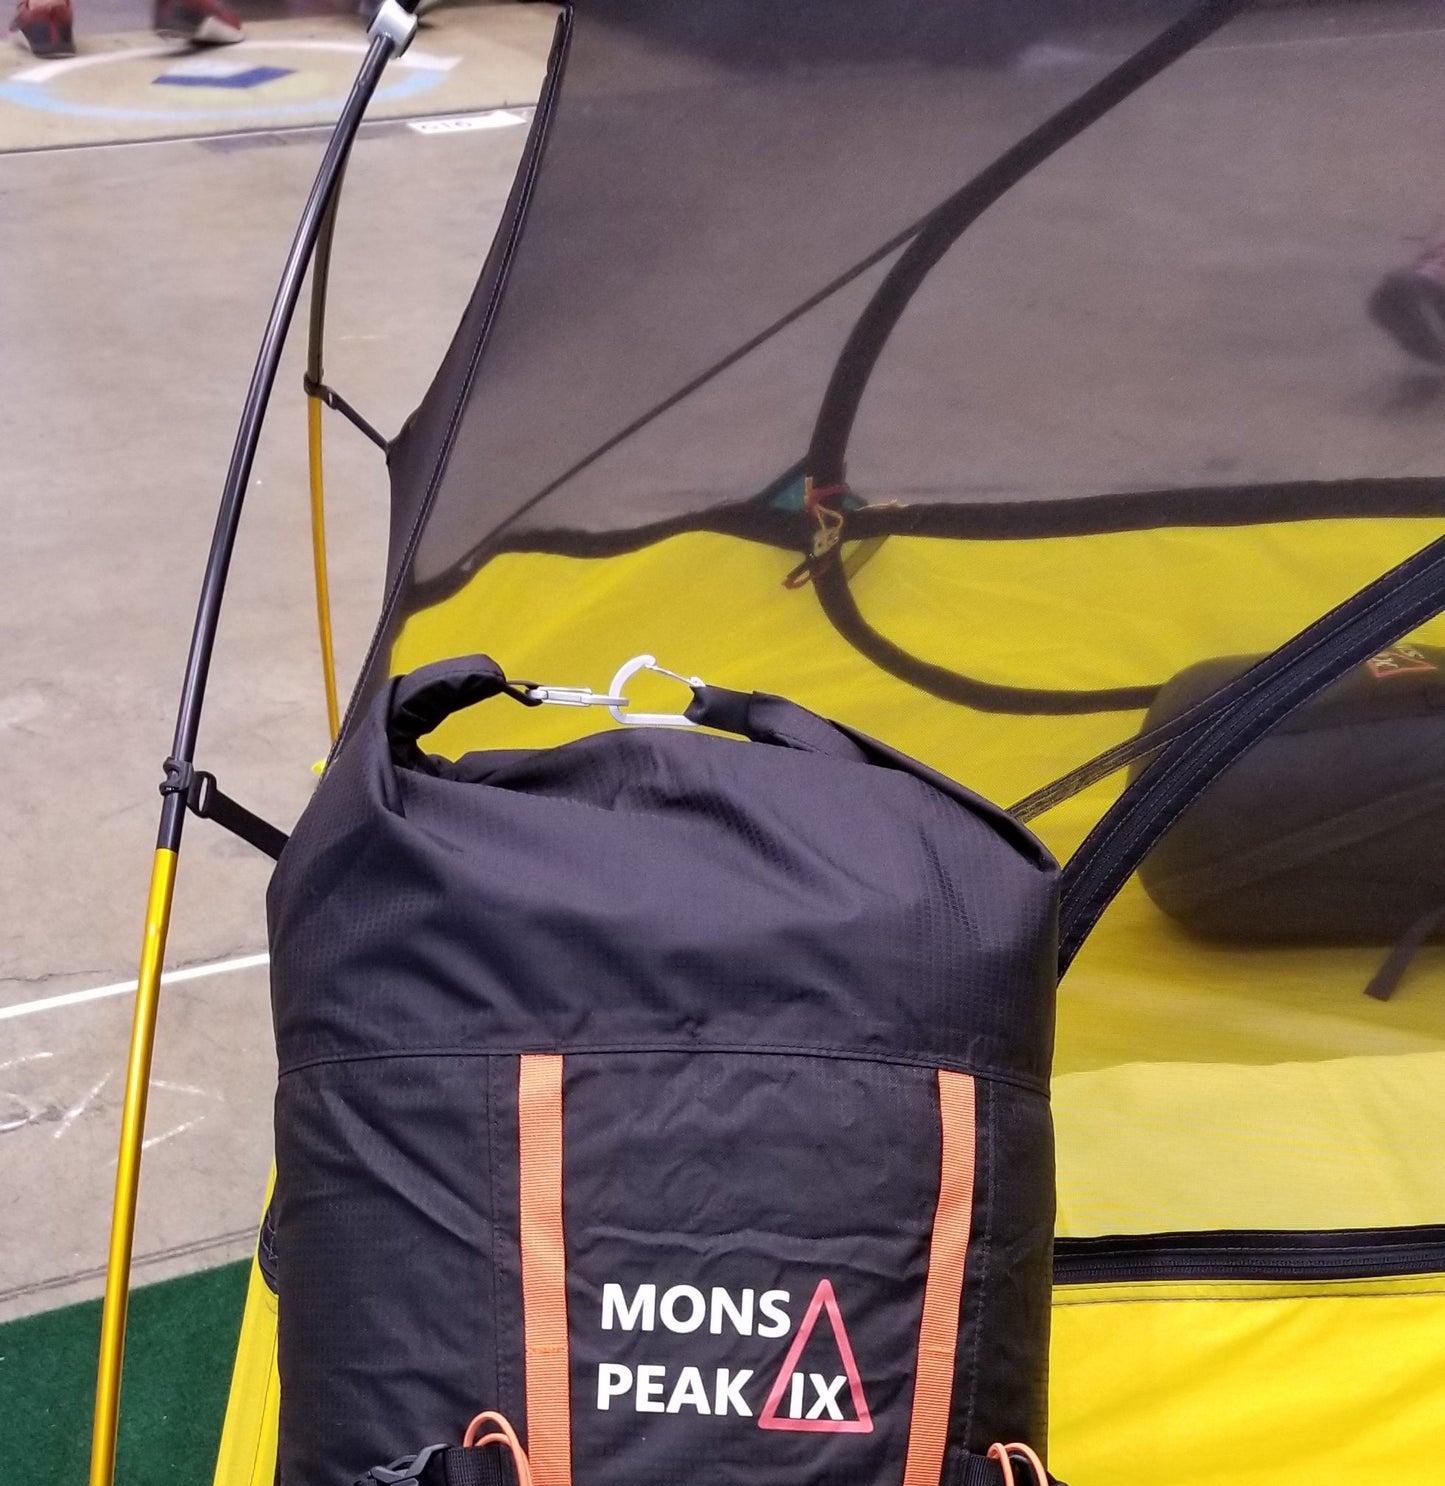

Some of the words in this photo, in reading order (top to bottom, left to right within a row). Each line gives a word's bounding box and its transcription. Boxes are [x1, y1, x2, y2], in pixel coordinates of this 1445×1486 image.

[601, 1283, 791, 1338] MONS
[597, 1363, 754, 1417] PEAK
[789, 1372, 847, 1420] IX
